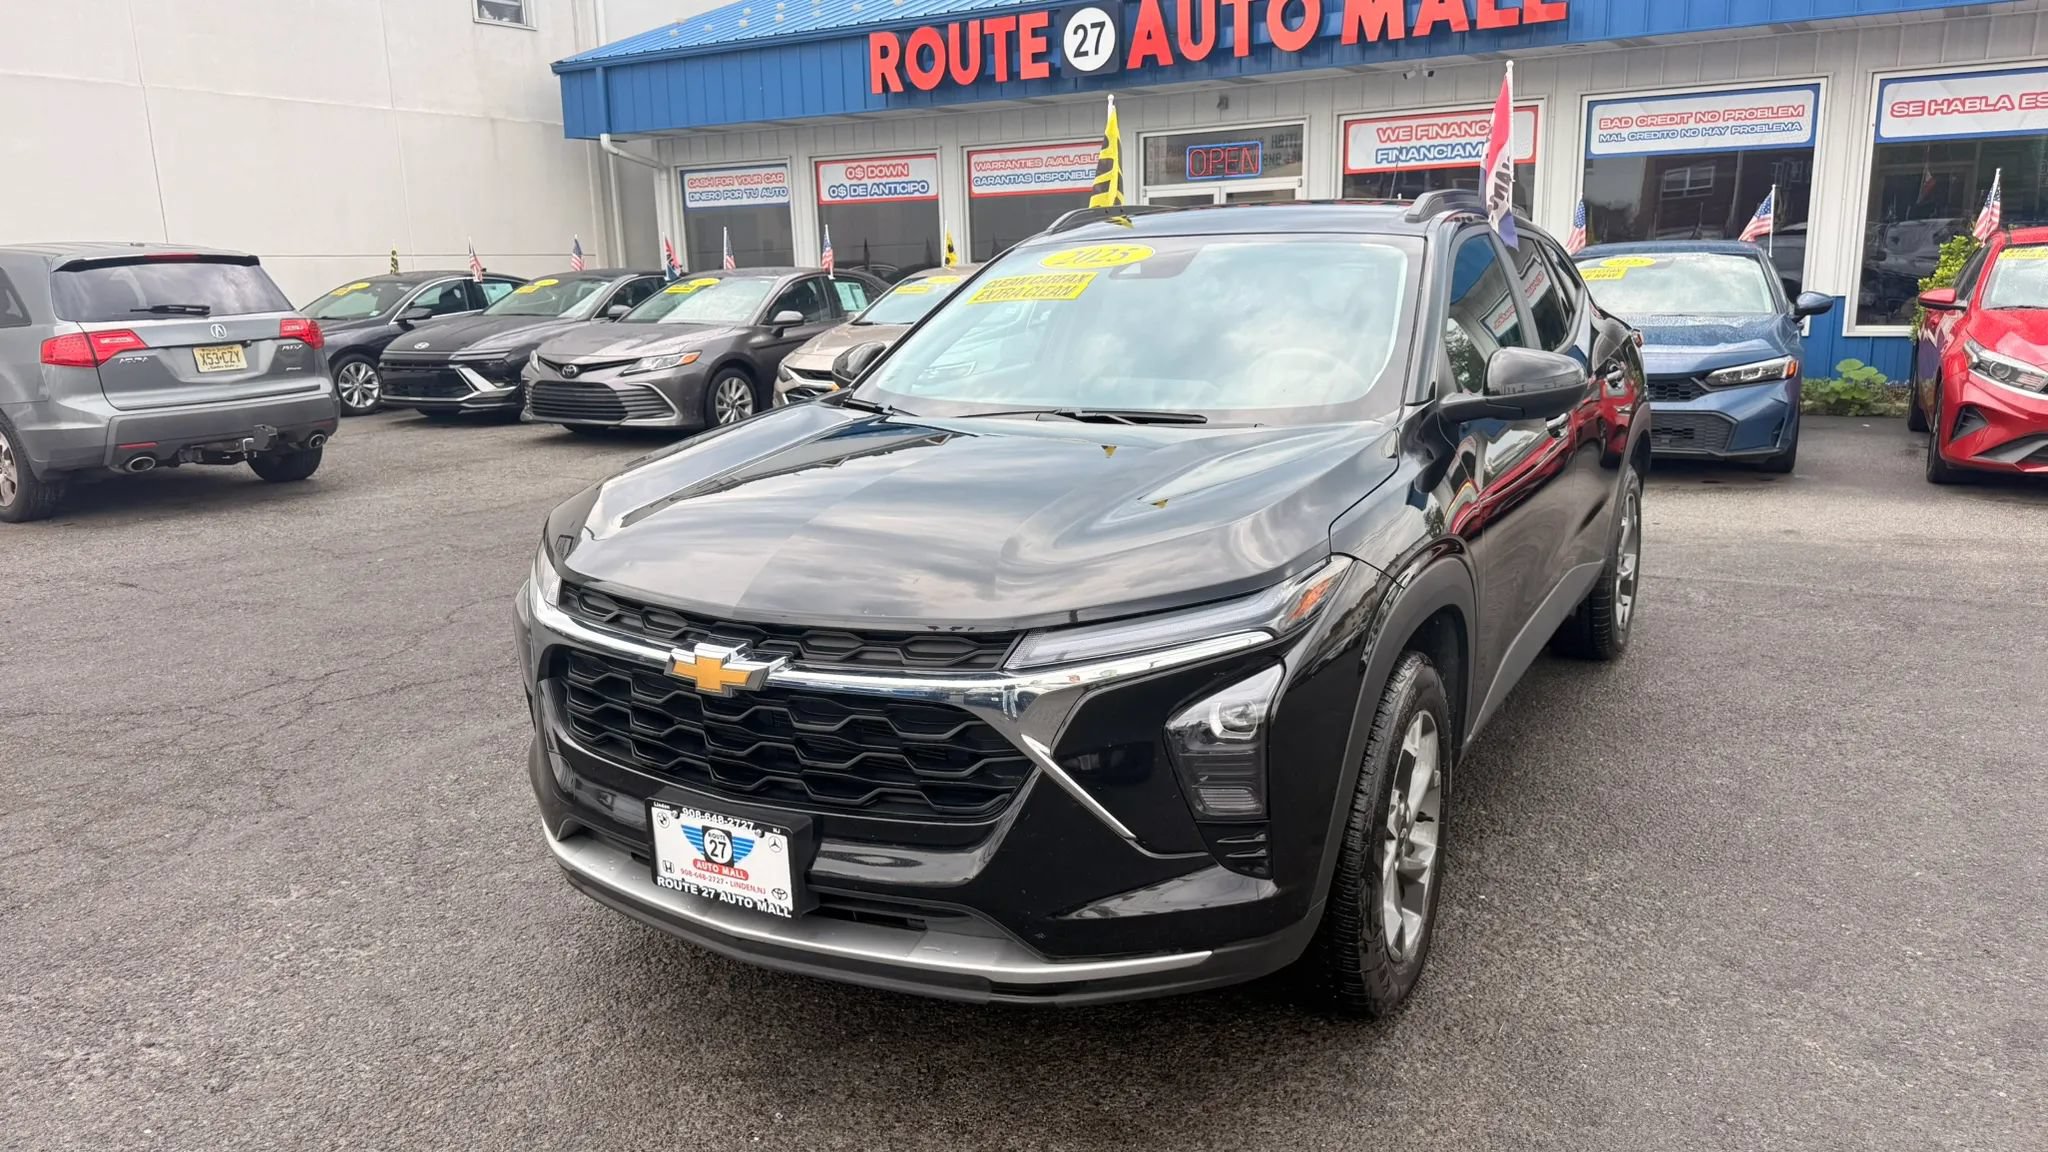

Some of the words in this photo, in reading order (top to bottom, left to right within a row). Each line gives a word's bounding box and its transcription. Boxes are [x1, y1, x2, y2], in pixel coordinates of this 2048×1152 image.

[869, 11, 1049, 94] ROUTE
[1072, 21, 1106, 58] 27
[1126, 0, 1320, 69] AUTO
[1890, 101, 1925, 118] SE
[1928, 95, 2015, 116] HABLA
[1600, 117, 1633, 130] BAD
[1636, 113, 1692, 127] CREDIT
[1695, 111, 1721, 123] NO
[1723, 104, 1804, 121] PROBLEM
[1377, 126, 1412, 143] WE
[1599, 133, 1626, 143] MAL
[1628, 129, 1678, 141] CREDITO
[1680, 128, 1700, 138] NO
[1701, 126, 1729, 136] HAY
[1730, 122, 1802, 134] PROBLEMA
[975, 159, 1043, 172] WARRANTIES
[1190, 146, 1259, 177] OPEN
[688, 178, 714, 189] CASH
[715, 176, 734, 187] FOR
[735, 174, 762, 186] YOUR
[764, 172, 784, 184] CAR
[845, 165, 865, 180] 0$
[867, 163, 909, 178] DOWN
[973, 173, 1032, 186] GARANTIAS
[689, 190, 721, 202] DINERO
[723, 189, 743, 200] POR
[744, 188, 759, 199] TU
[760, 186, 788, 198] AUTO
[828, 184, 848, 199] 0$
[850, 183, 868, 198] DE
[869, 180, 929, 197] ANTICIPO
[1054, 247, 1141, 265] 2025
[976, 287, 1023, 301] EXTRA
[1022, 285, 1078, 298] CLEAN
[682, 807, 754, 831] 908-648-2727
[708, 832, 726, 841] ROUTE
[709, 839, 727, 859] 27
[696, 861, 720, 874] AUTO
[721, 865, 745, 880] MALL
[657, 876, 698, 895] ROUTE
[701, 886, 716, 899] 27
[718, 891, 754, 909] AUTO
[756, 899, 792, 919] MALL
